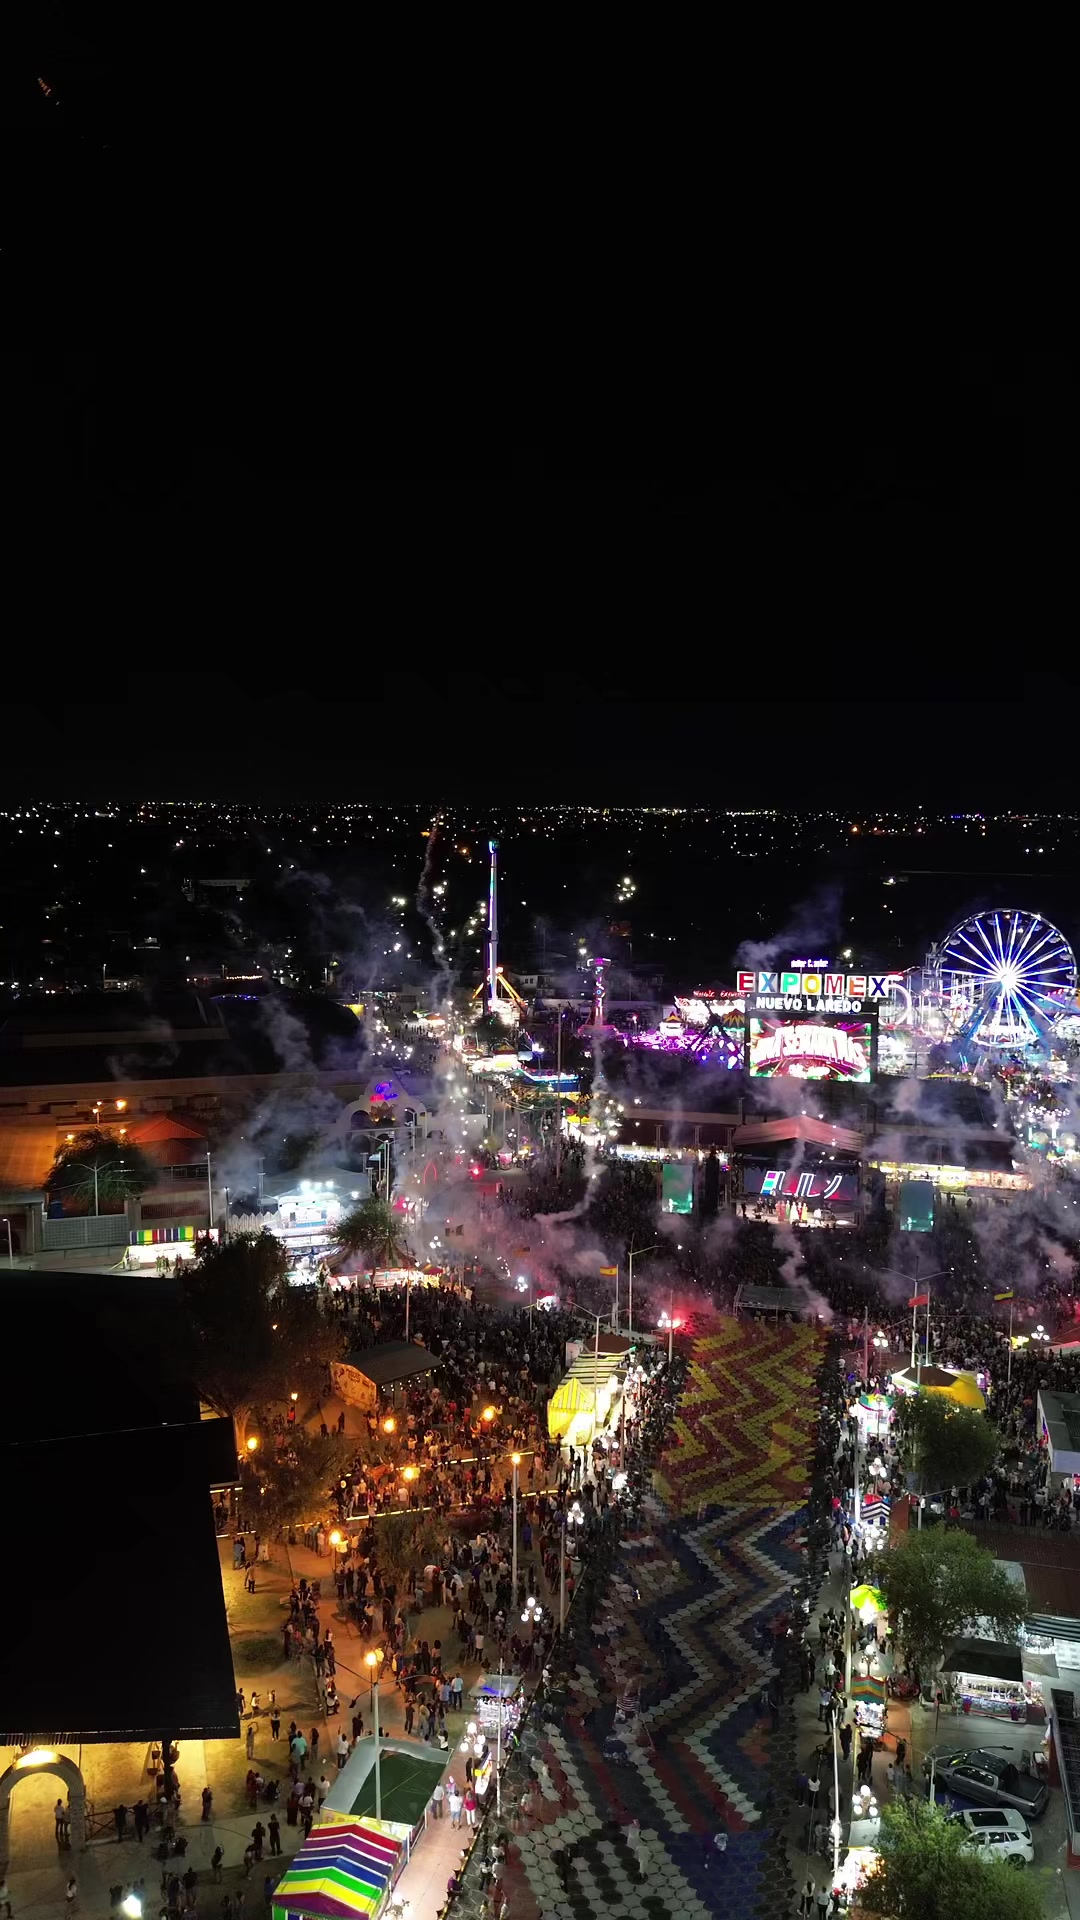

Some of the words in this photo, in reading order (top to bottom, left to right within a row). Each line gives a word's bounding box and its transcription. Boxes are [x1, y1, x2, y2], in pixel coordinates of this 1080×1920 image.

[738, 971, 888, 997] EXPOMEX
[756, 997, 802, 1010] NUEVO
[807, 998, 862, 1013] LAREDO
